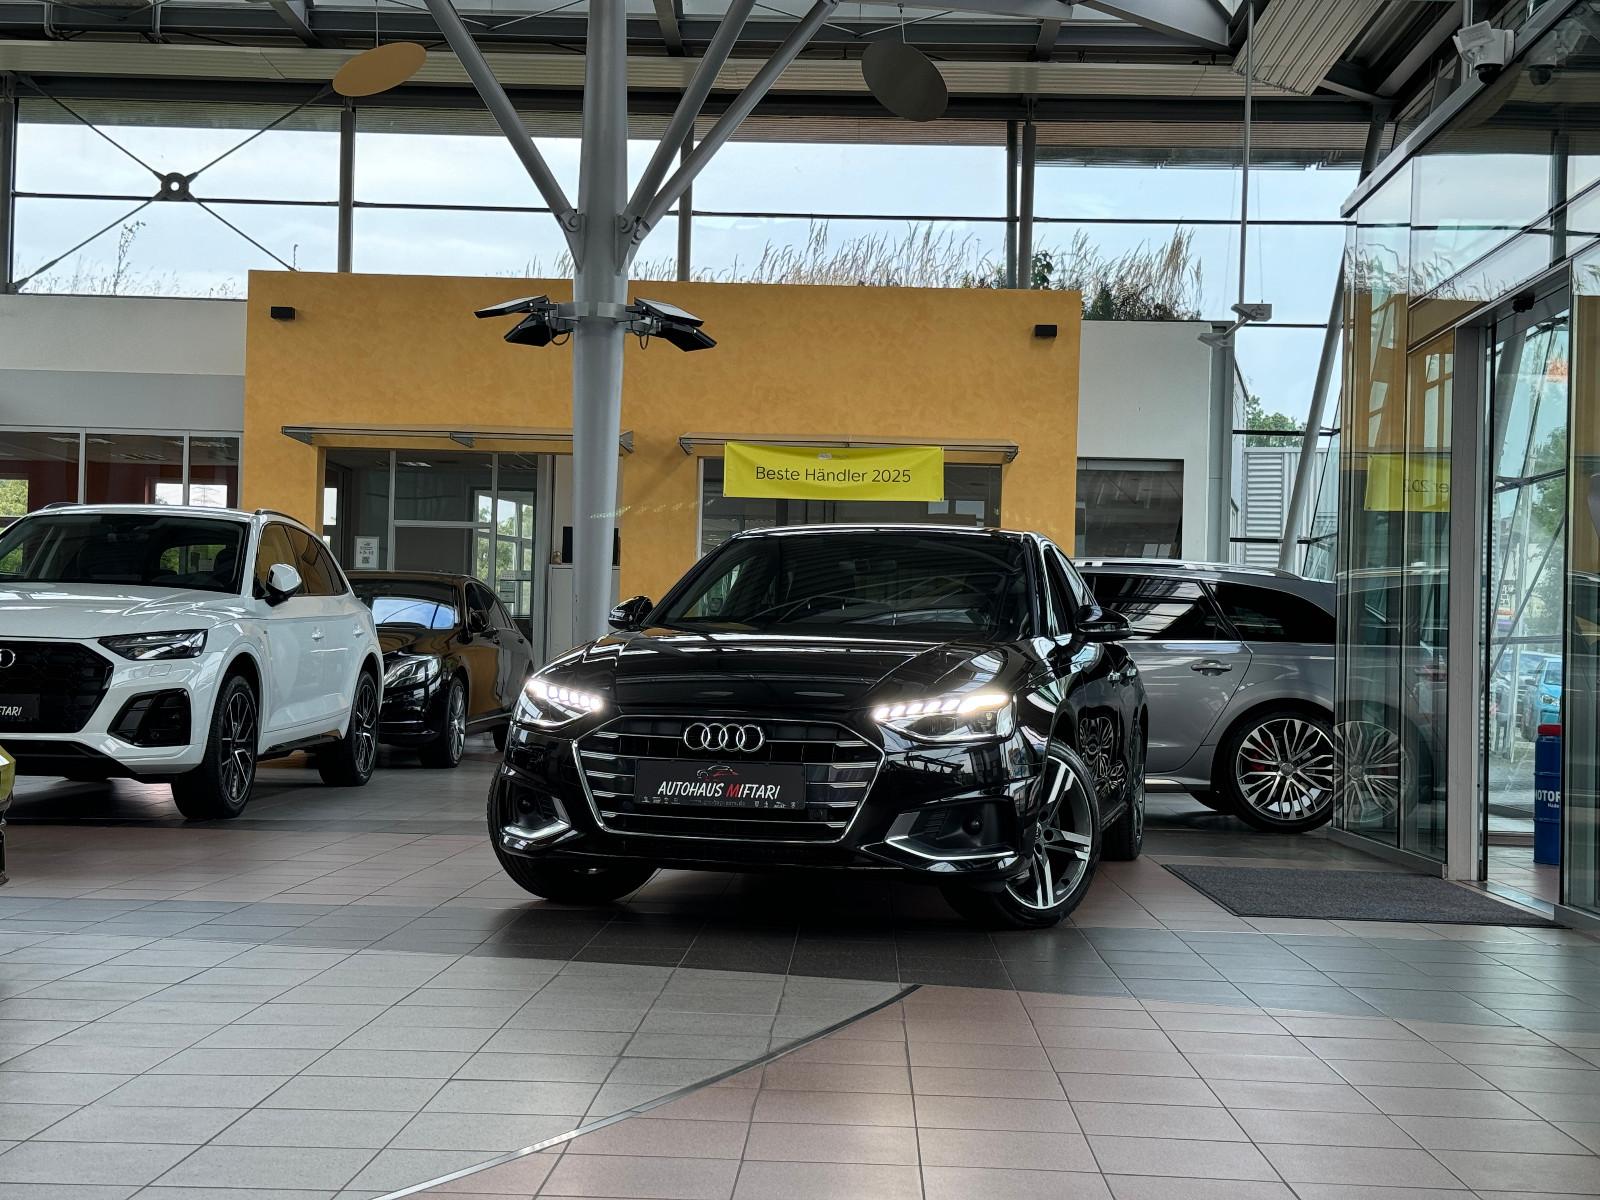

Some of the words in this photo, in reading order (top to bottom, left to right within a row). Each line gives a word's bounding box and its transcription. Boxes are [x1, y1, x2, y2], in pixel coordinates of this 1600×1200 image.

[756, 467, 800, 481] Beste
[805, 468, 867, 483] Händler
[872, 470, 911, 483] 2025
[657, 781, 725, 797] AUTOHAUS
[726, 783, 780, 800] MIFTARI
